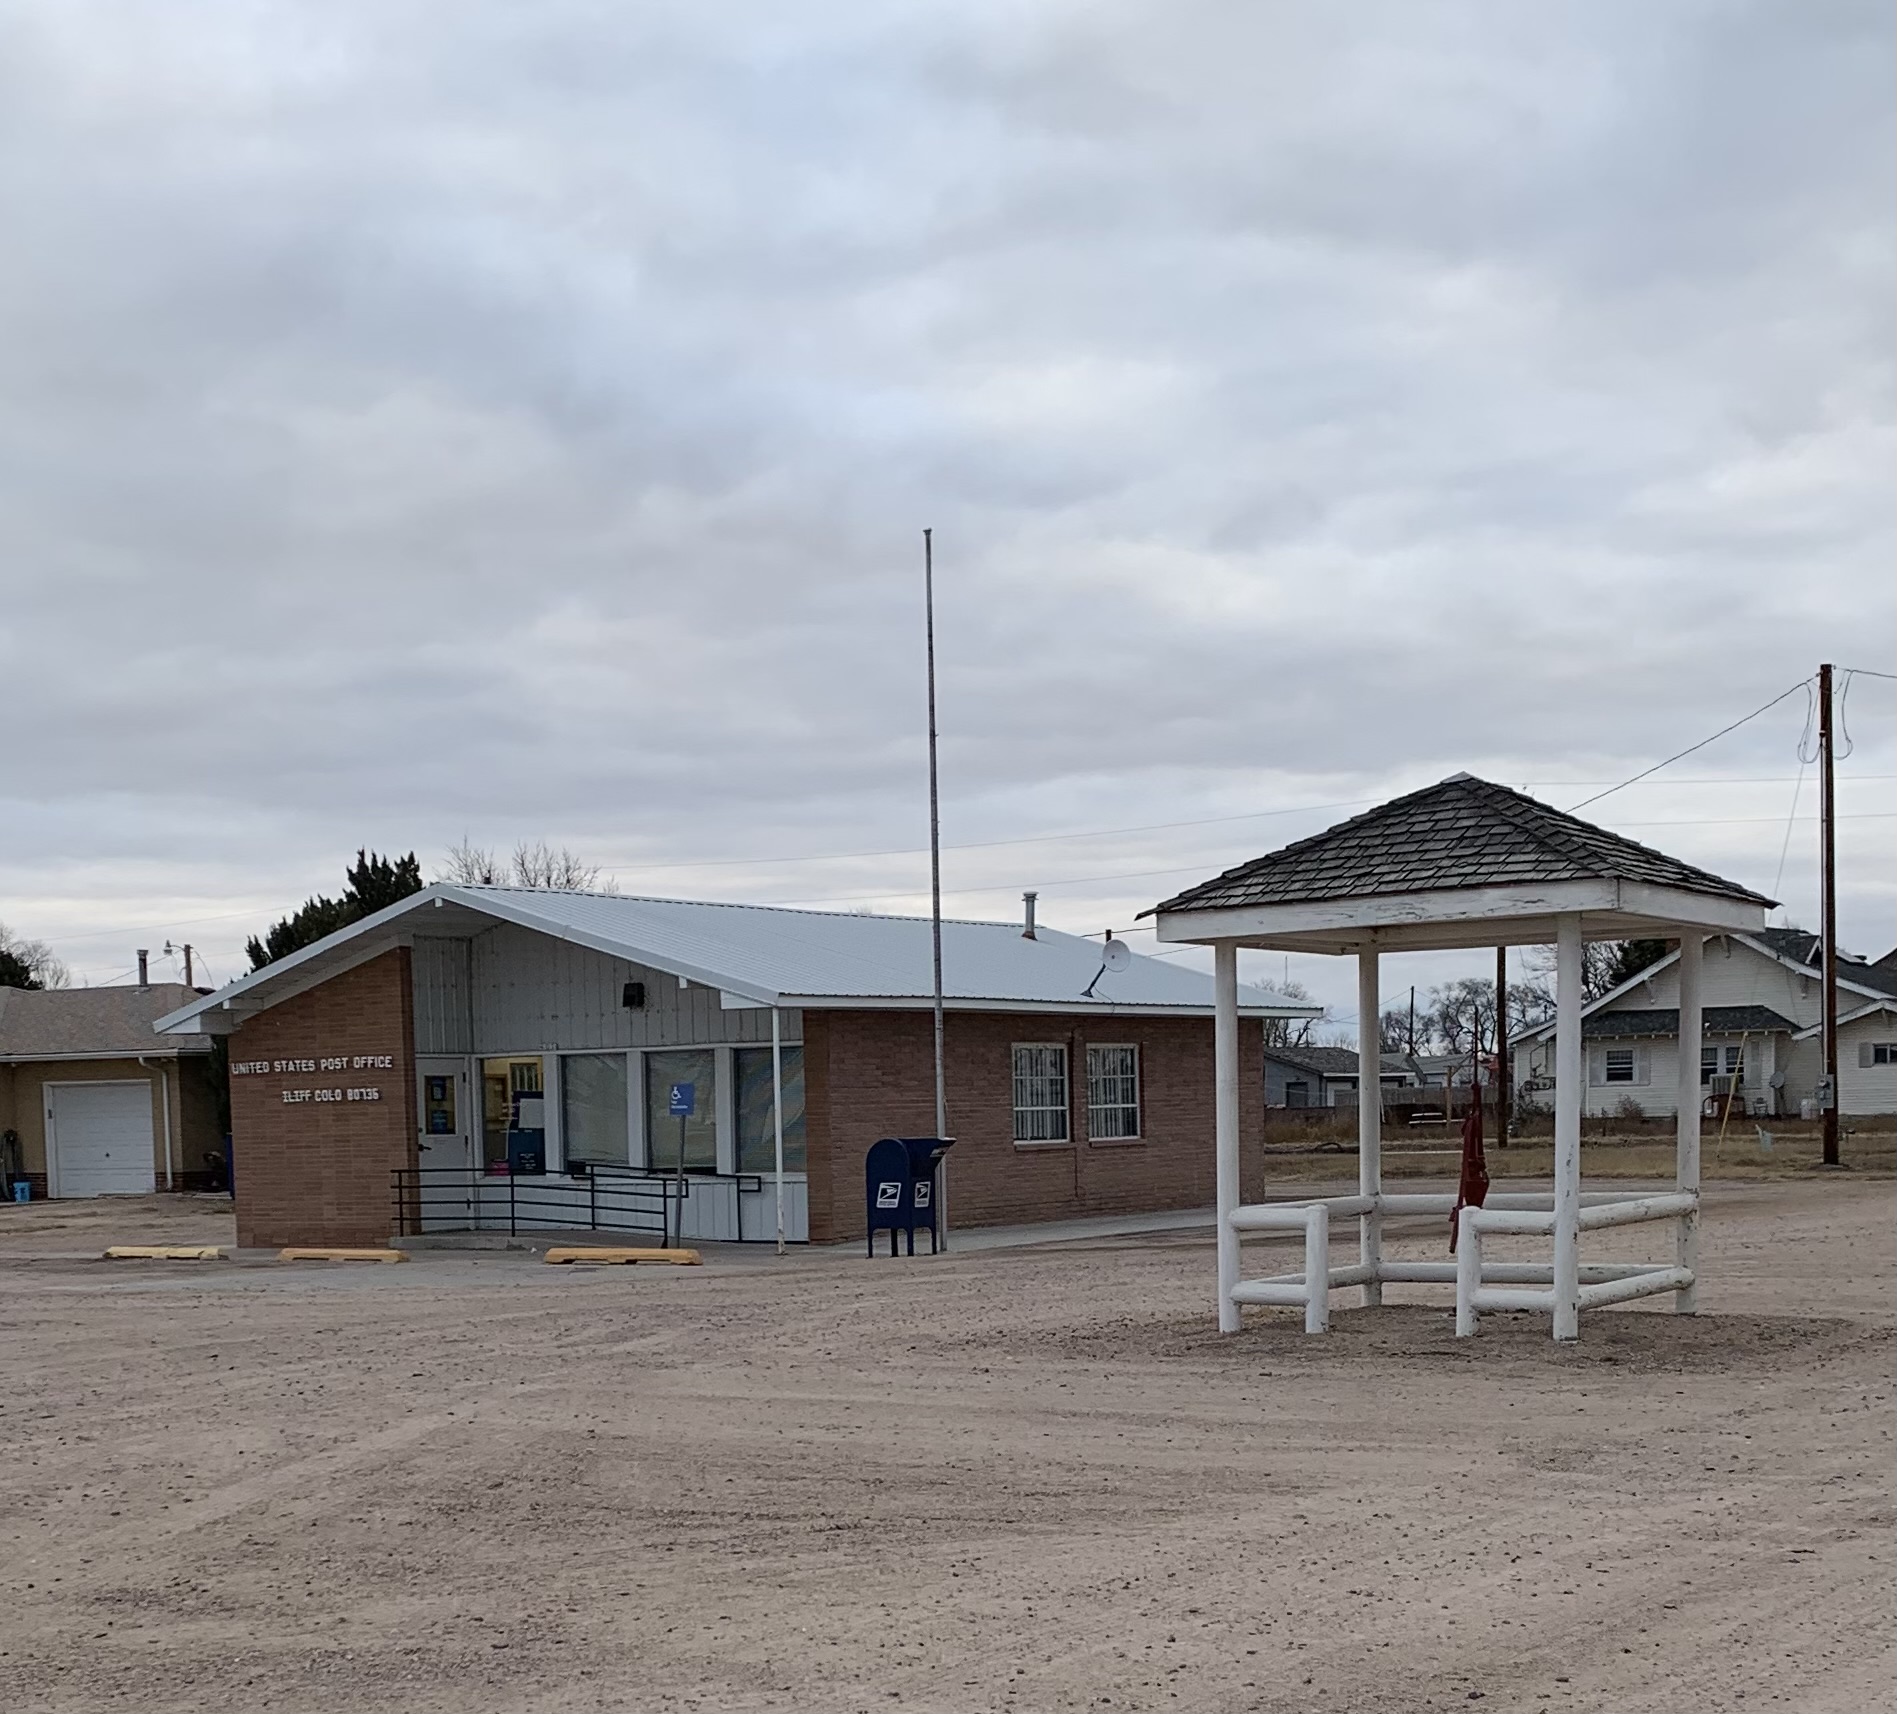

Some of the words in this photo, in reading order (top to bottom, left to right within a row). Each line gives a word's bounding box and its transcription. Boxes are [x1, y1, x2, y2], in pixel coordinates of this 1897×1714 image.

[231, 1061, 270, 1074] UNITED
[274, 1060, 316, 1072] STATES
[320, 1057, 349, 1071] POST
[353, 1055, 393, 1069] OFFICE
[282, 1089, 312, 1102] ILIFF
[314, 1088, 342, 1102] COLO
